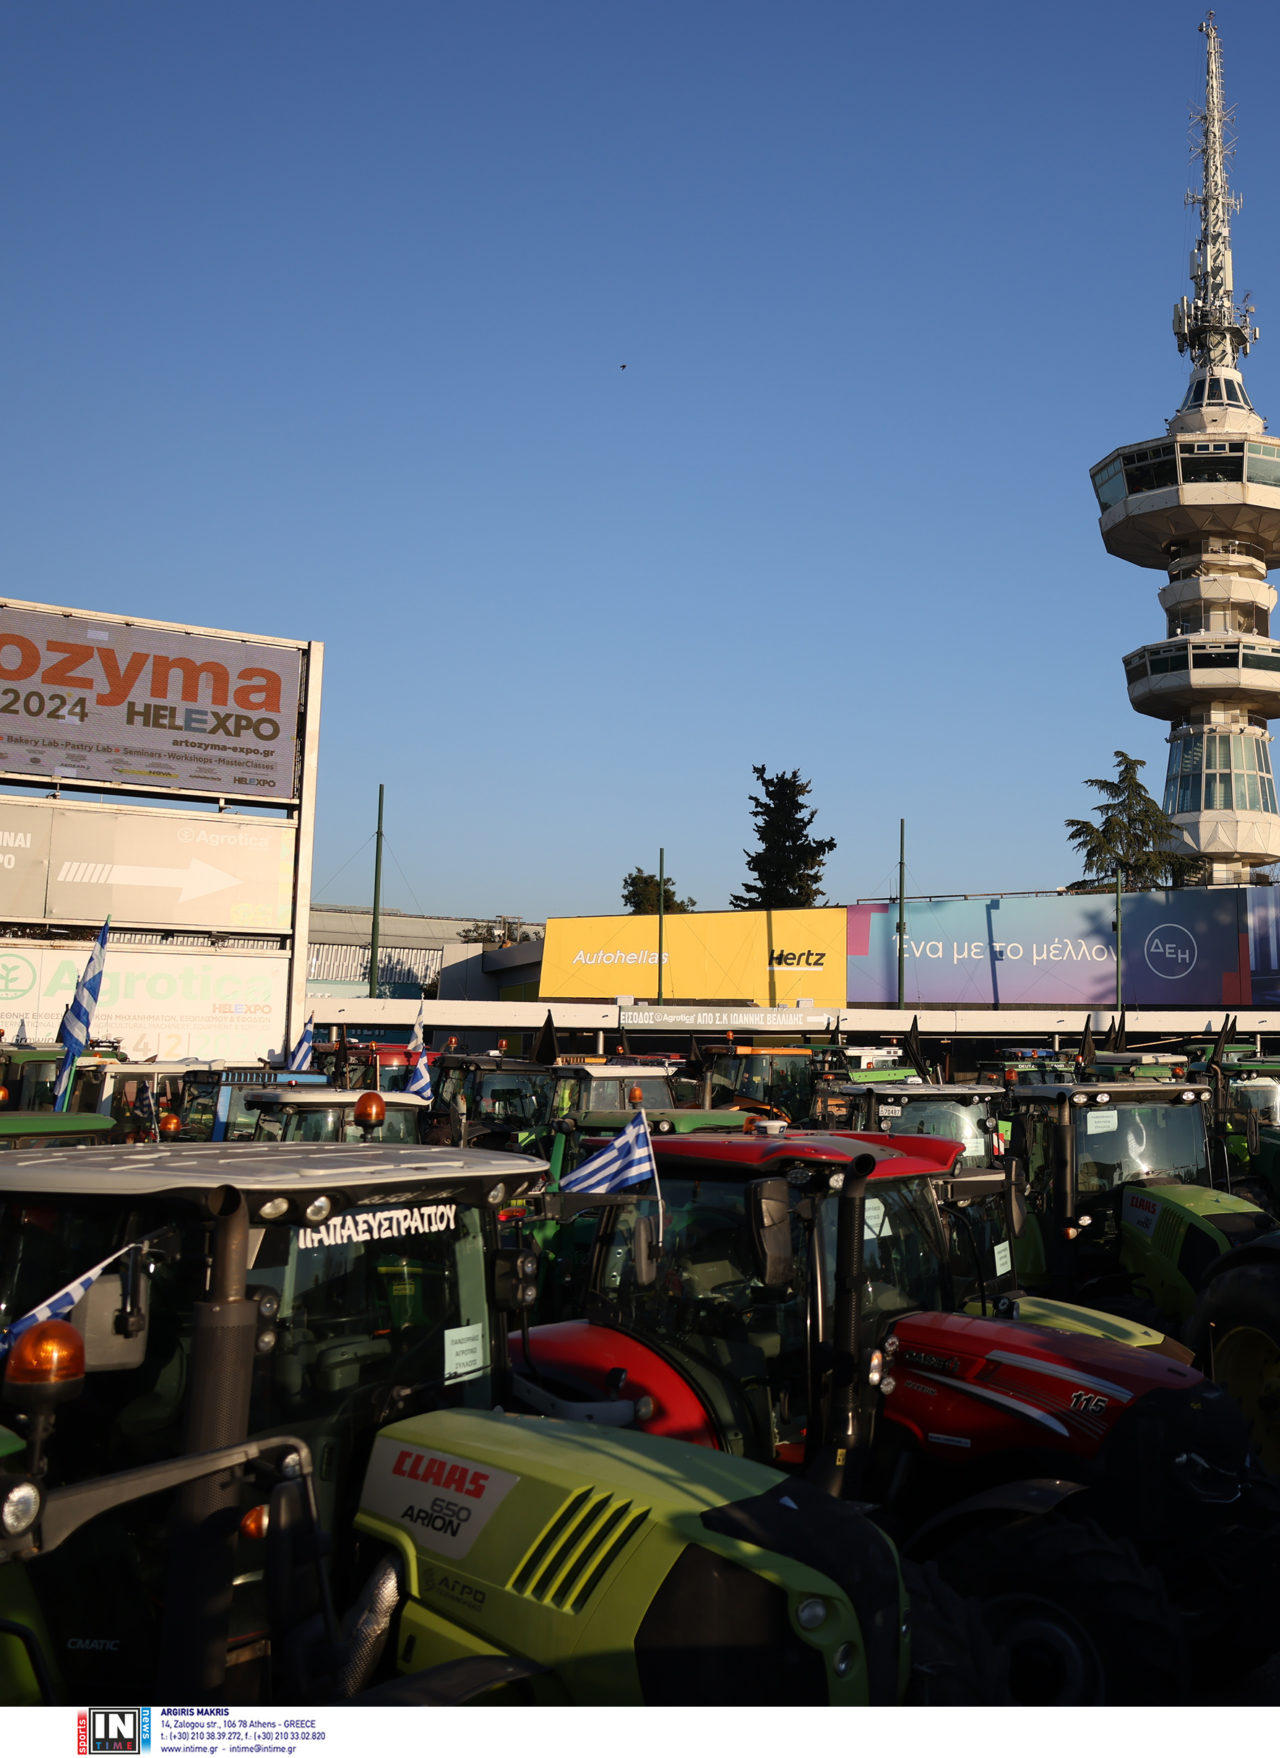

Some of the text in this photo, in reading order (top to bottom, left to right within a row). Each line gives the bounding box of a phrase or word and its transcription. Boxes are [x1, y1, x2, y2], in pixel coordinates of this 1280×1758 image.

[0, 633, 282, 713] ozyma
[1, 688, 88, 723] 2024
[126, 701, 280, 742] HELEXPO
[7, 735, 39, 747] Bakery
[42, 739, 59, 747] Lab
[96, 744, 112, 753] Lab
[123, 748, 162, 759] Seminars
[172, 738, 276, 758] artozyma-expo.gr
[233, 776, 276, 788] HELEXPO
[196, 830, 270, 848] Agrotica
[572, 949, 669, 965] Autohellas
[767, 948, 826, 967] Hertz
[953, 941, 984, 965] με
[993, 942, 1024, 960] το
[1150, 938, 1190, 963] ΔΕΗ
[212, 1003, 273, 1014] HELEXPO
[620, 1011, 655, 1024] ΕΙΣΟΔΟΣ
[662, 1013, 695, 1022] Agrotica
[697, 1013, 713, 1024] ΑΠΟ
[730, 1013, 765, 1025] ΙΩΑΝΝΗΣ
[767, 1014, 804, 1025] ΒΕΛΛΙΔΗΣ
[1070, 1390, 1108, 1415] 115
[392, 1450, 490, 1499] CLAAS
[430, 1497, 472, 1523] 650
[401, 1505, 462, 1537] ARION
[66, 1638, 120, 1651] CMATIC
